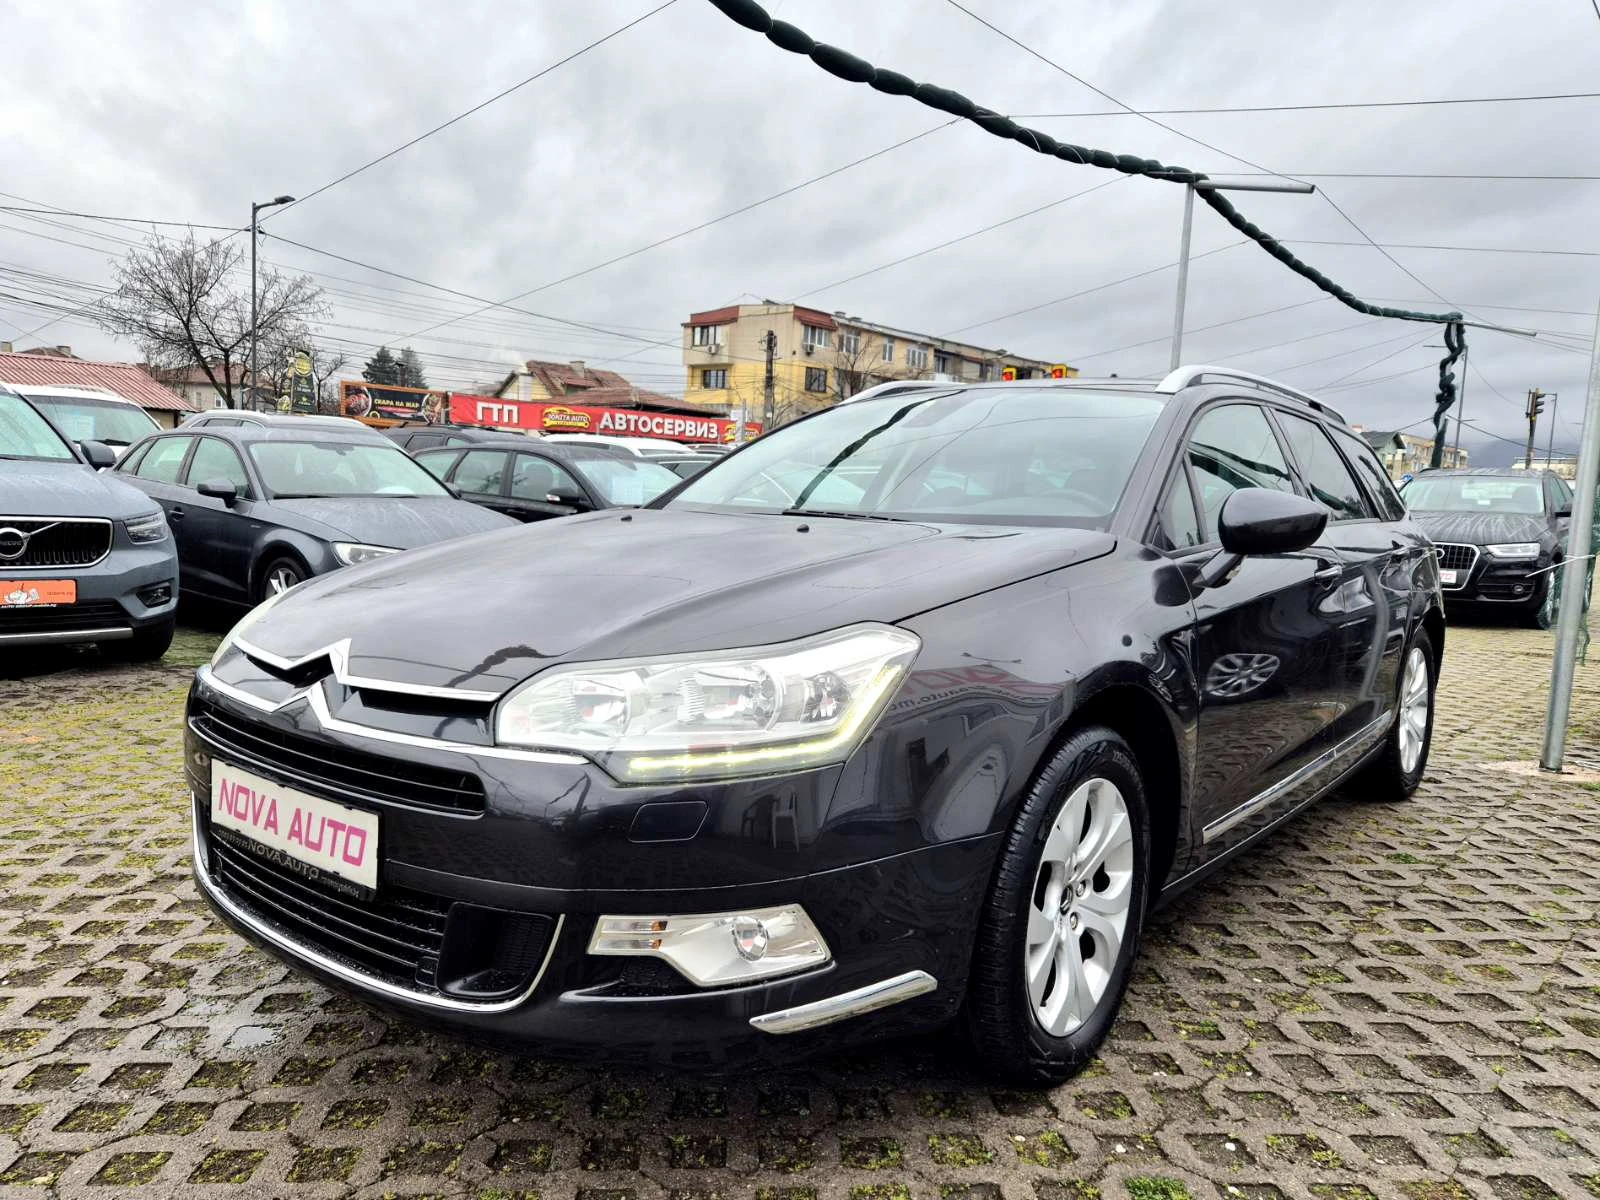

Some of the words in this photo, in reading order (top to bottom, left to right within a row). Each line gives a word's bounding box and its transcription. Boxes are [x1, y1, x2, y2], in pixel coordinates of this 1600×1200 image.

[476, 401, 518, 423] ГТП
[600, 411, 718, 439] АВТОСЕРВИЗ
[218, 778, 279, 835] NOVA
[287, 807, 368, 868] AUTO
[249, 839, 282, 865] NOVA
[281, 855, 319, 879] AUTO
